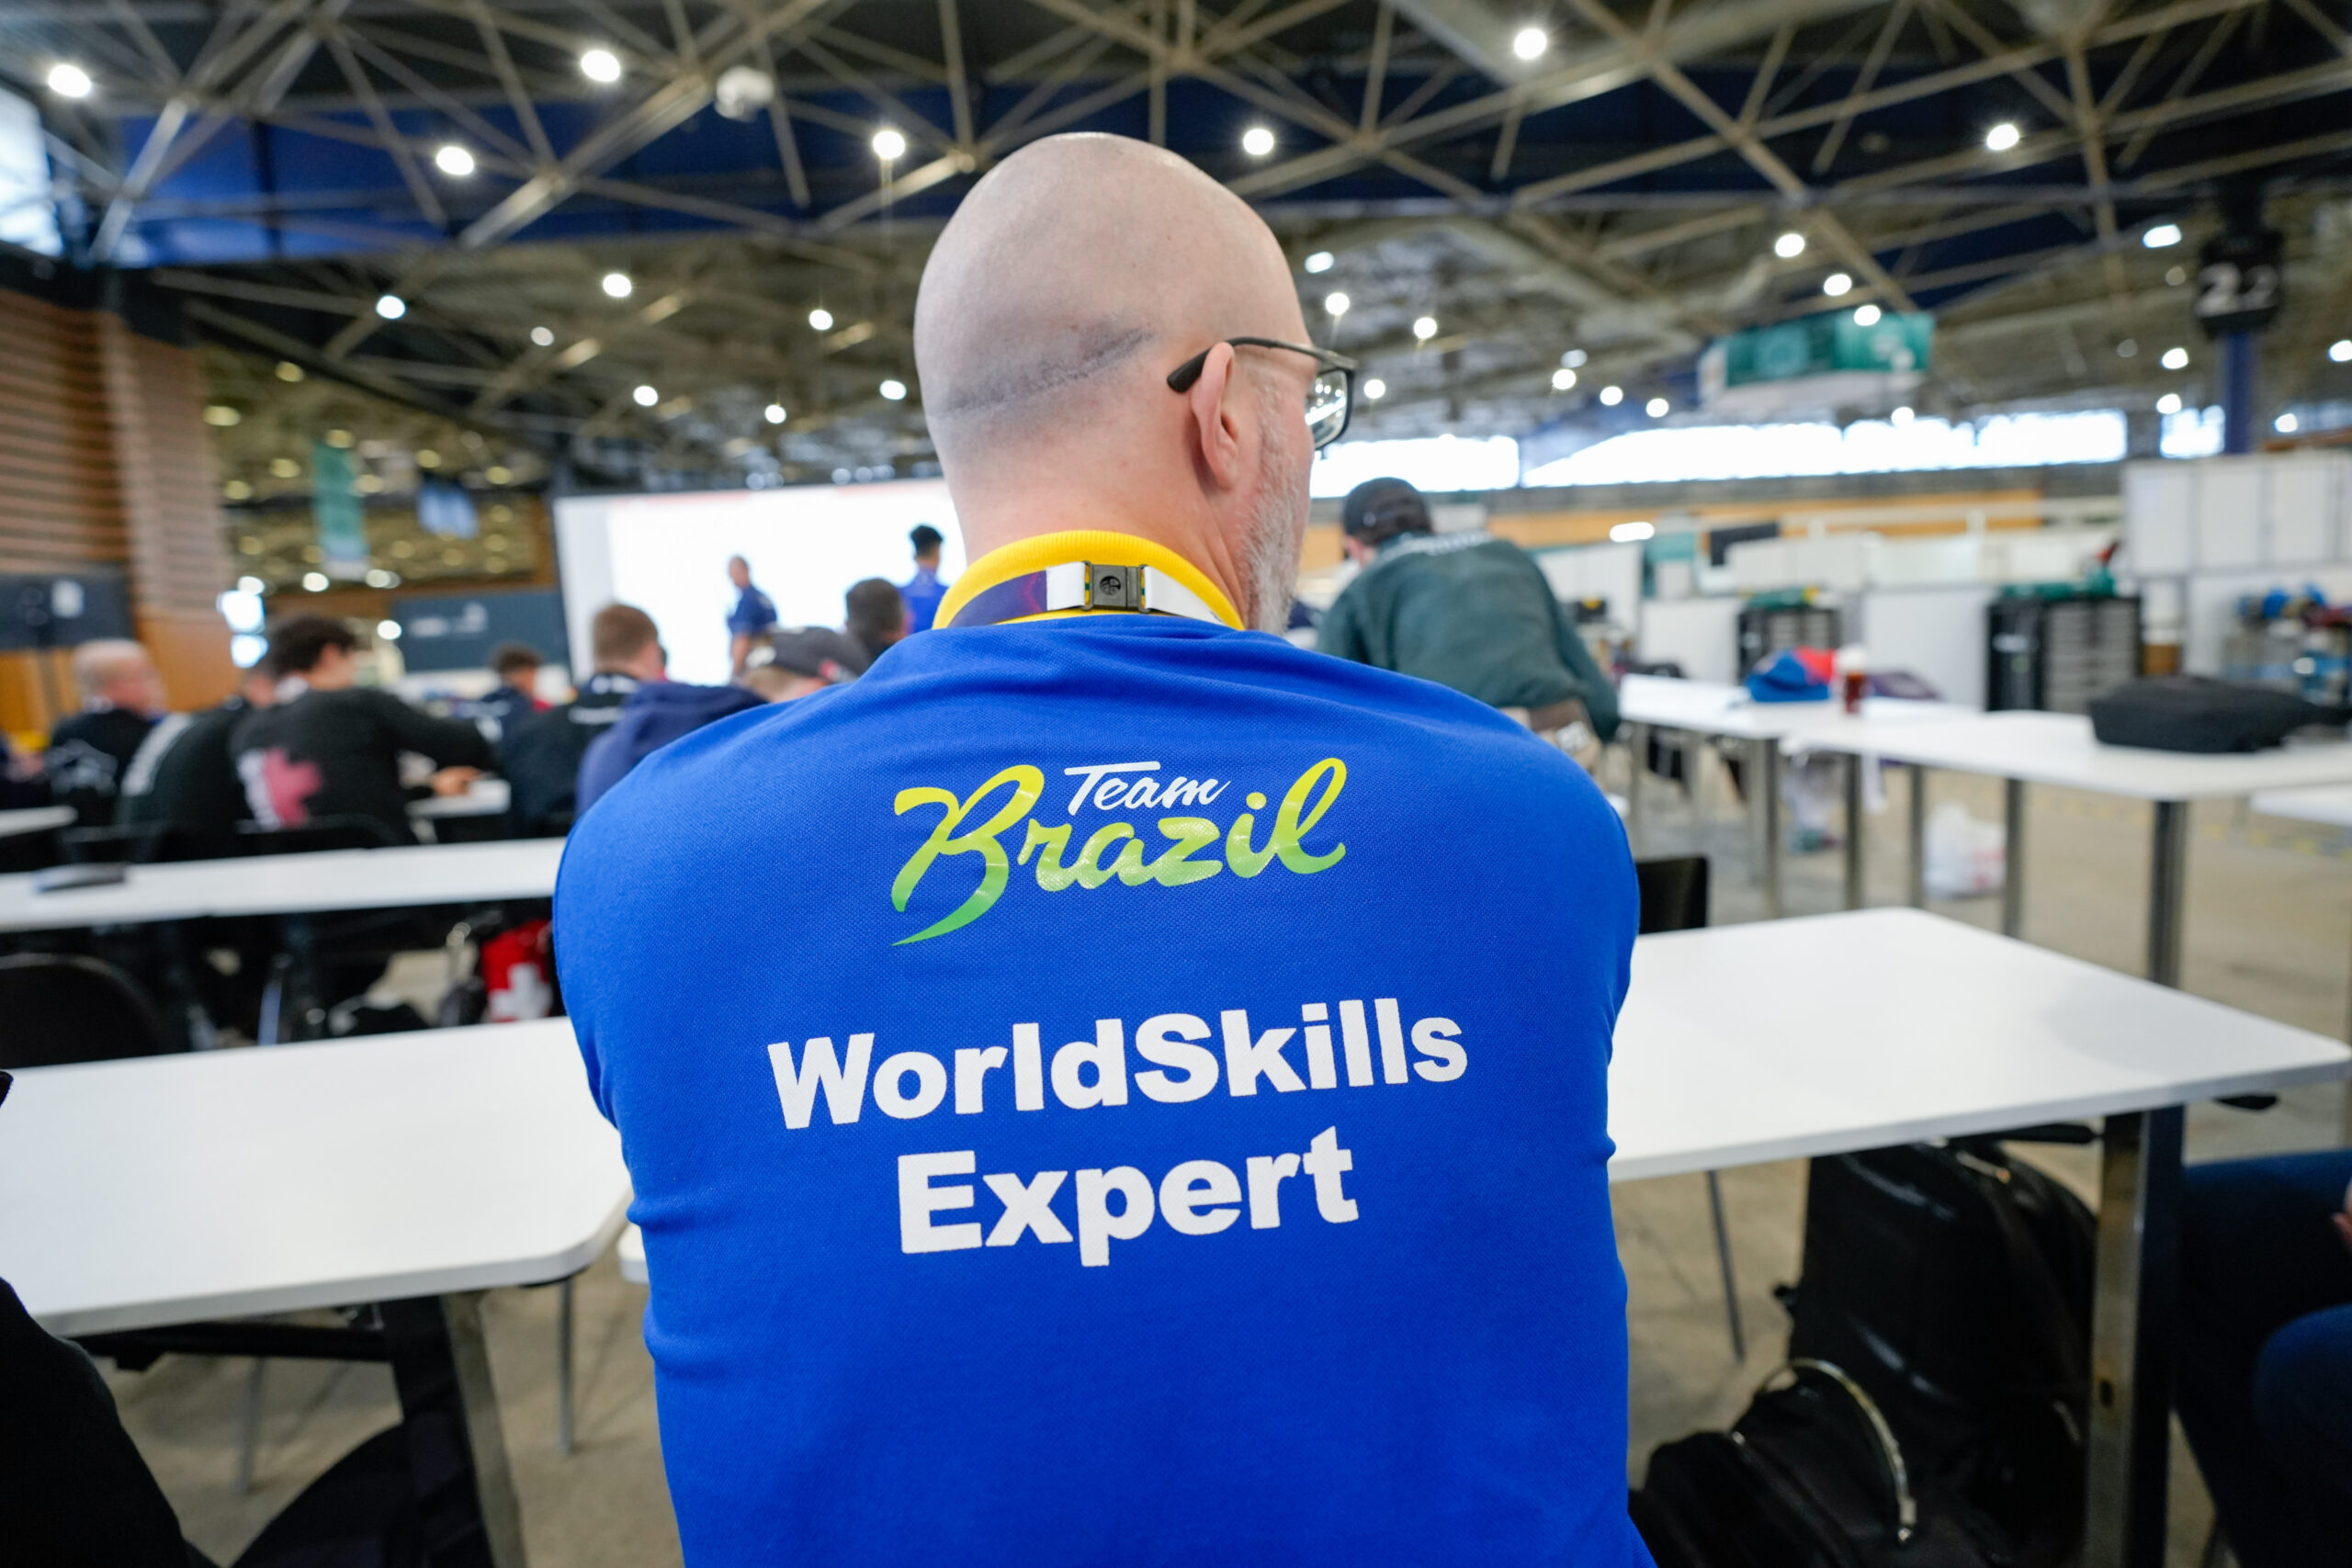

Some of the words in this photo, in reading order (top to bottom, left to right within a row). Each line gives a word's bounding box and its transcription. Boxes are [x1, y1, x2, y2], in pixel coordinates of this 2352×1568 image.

[891, 758, 1348, 946] Brazil
[1064, 761, 1231, 816] Team
[767, 998, 1468, 1130] WorldSkills
[898, 1126, 1359, 1268] Expert
